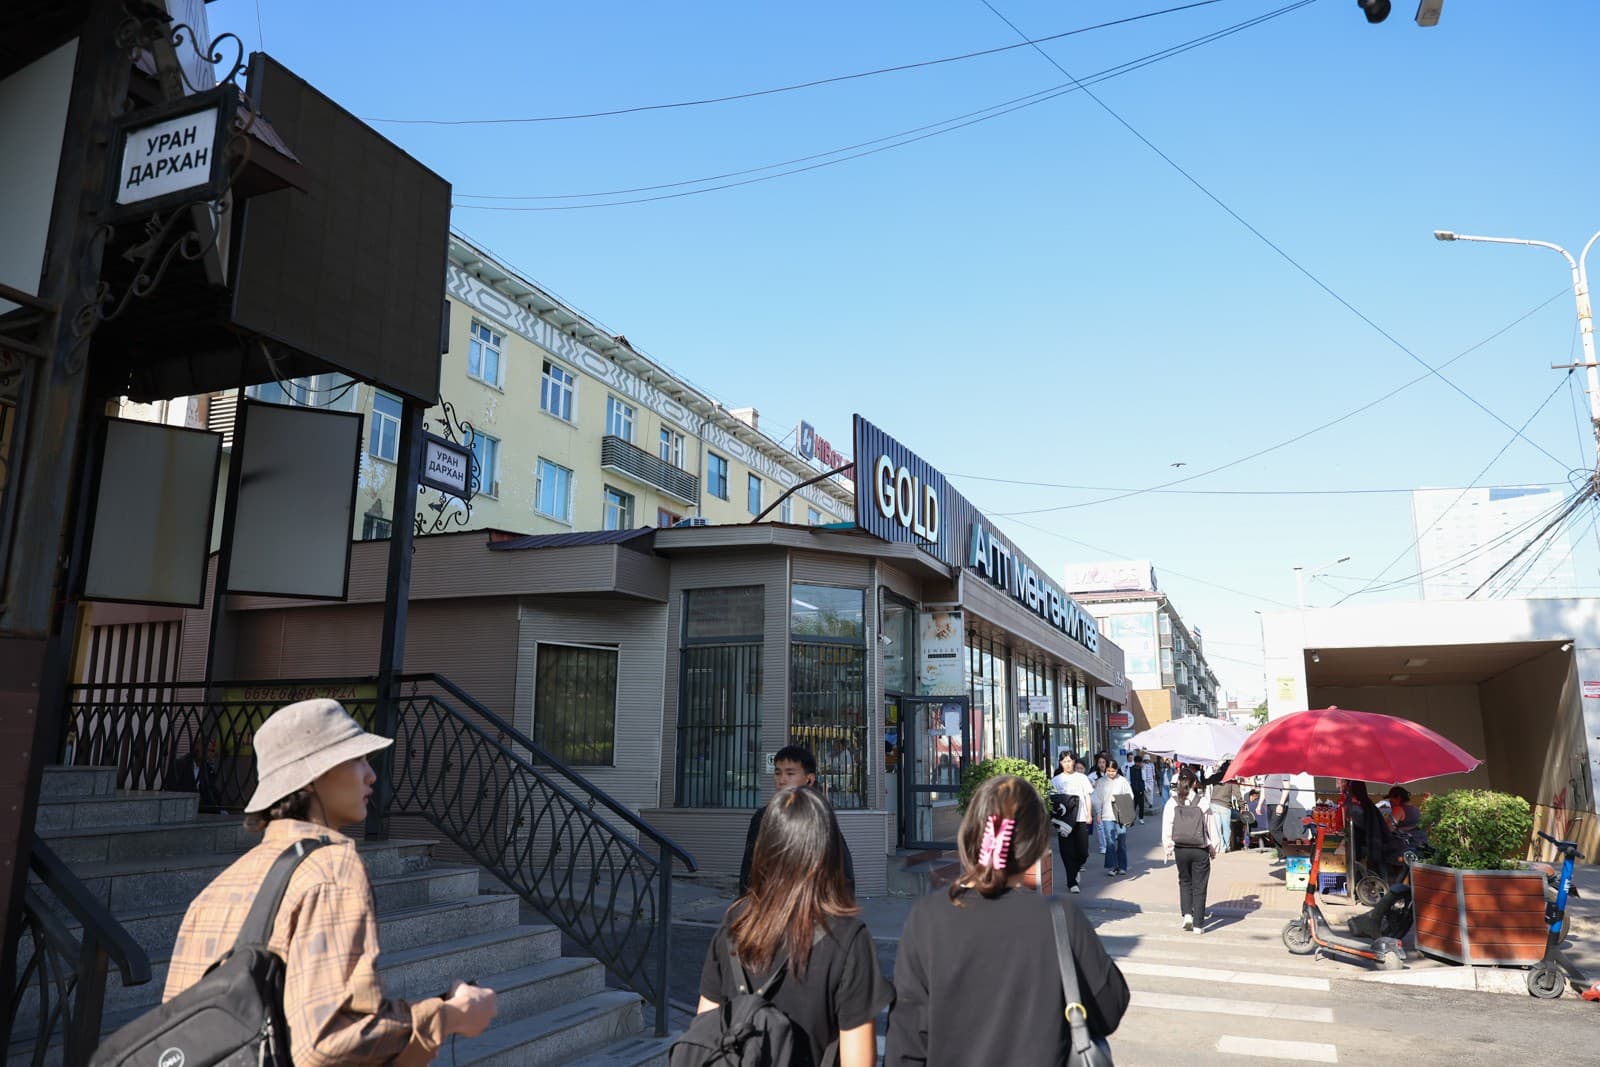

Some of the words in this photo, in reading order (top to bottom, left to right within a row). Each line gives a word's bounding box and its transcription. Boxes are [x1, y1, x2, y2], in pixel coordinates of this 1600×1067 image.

[146, 125, 197, 156] УРАН
[126, 147, 208, 189] ДАРХАН
[429, 460, 464, 481] ДАРХАН
[437, 450, 459, 467] УРАН
[875, 454, 938, 543] GOLD
[971, 522, 1011, 590] АЛТ
